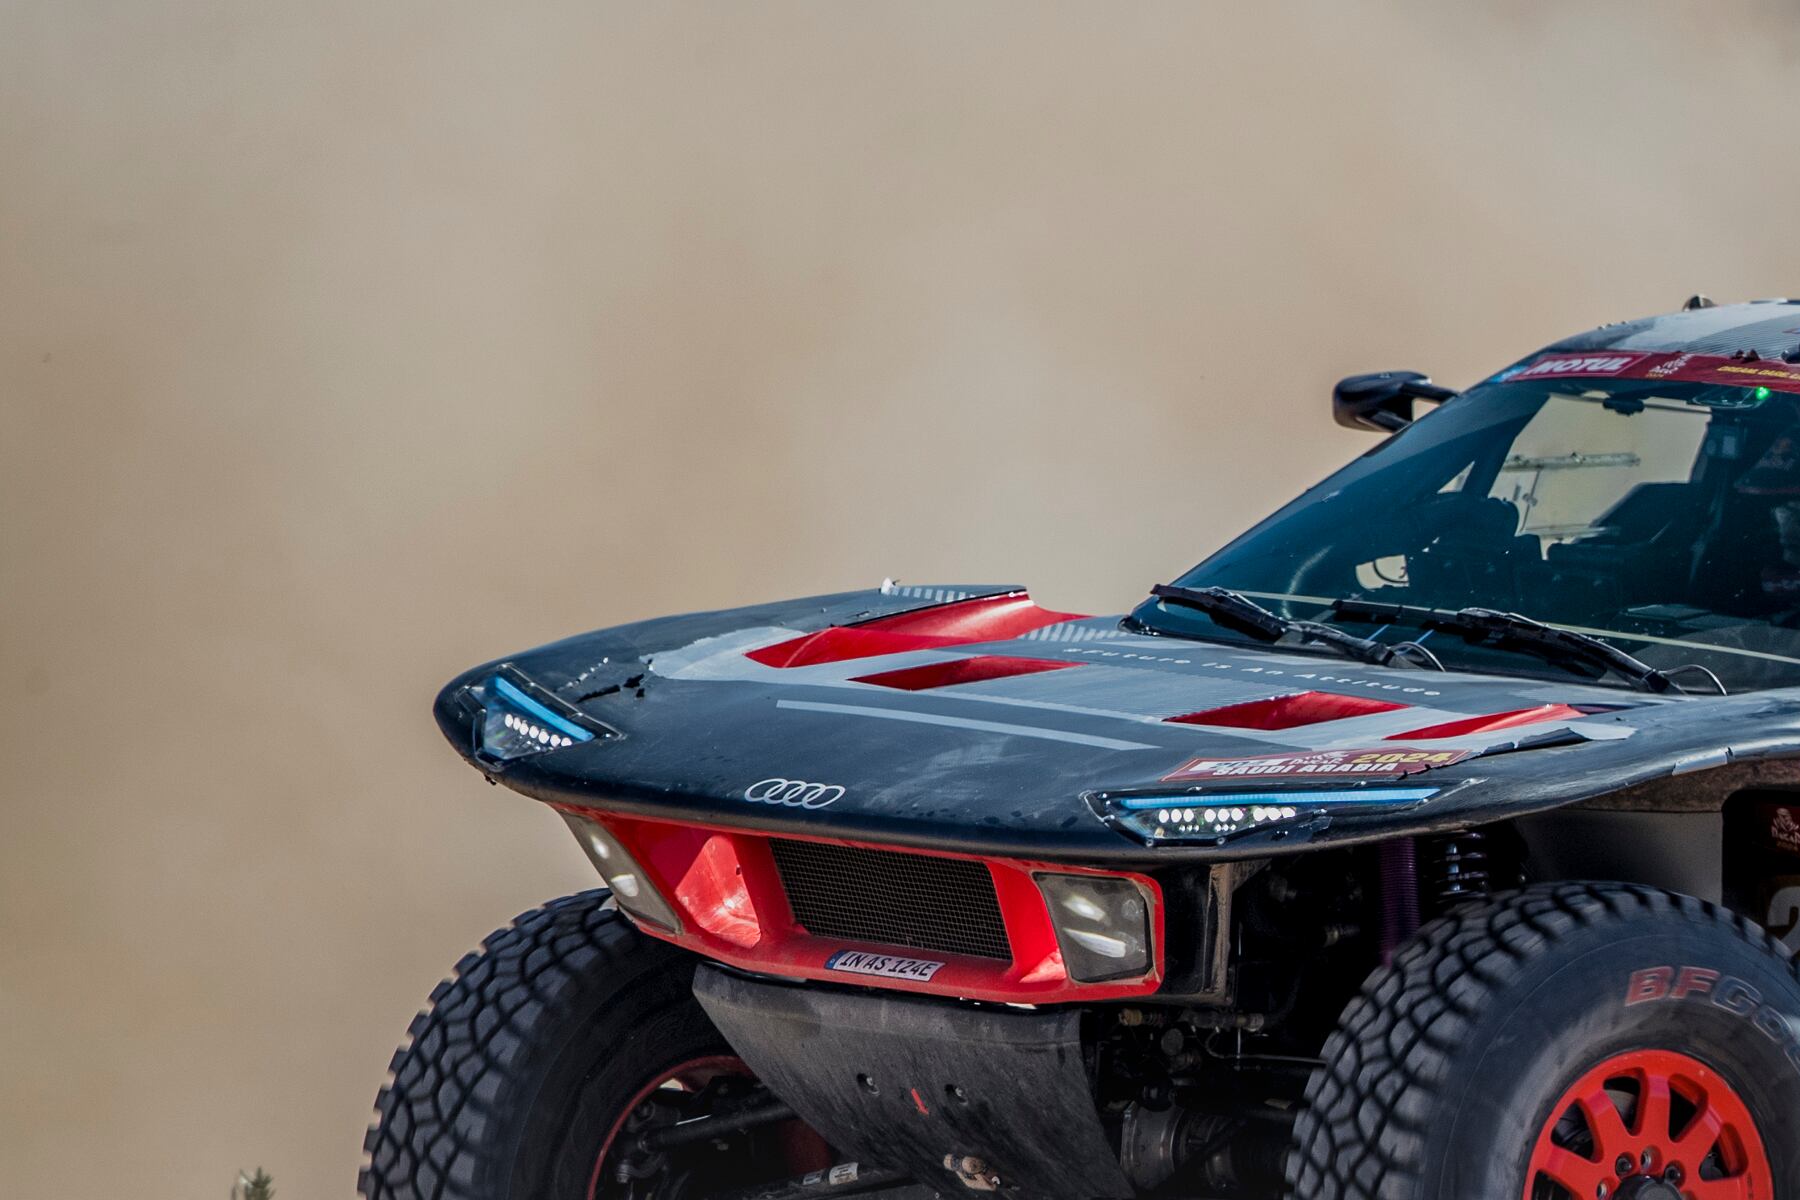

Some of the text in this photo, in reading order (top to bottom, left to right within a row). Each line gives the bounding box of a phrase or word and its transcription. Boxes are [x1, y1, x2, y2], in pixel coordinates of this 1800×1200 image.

[1525, 357, 1632, 376] MOTUL
[1240, 667, 1284, 675] An
[1293, 673, 1440, 696] Attitude
[1353, 752, 1453, 764] 2024
[1212, 765, 1296, 776] SAUDI
[1296, 763, 1398, 773] ARABIA
[840, 953, 938, 977] IN AS 124E
